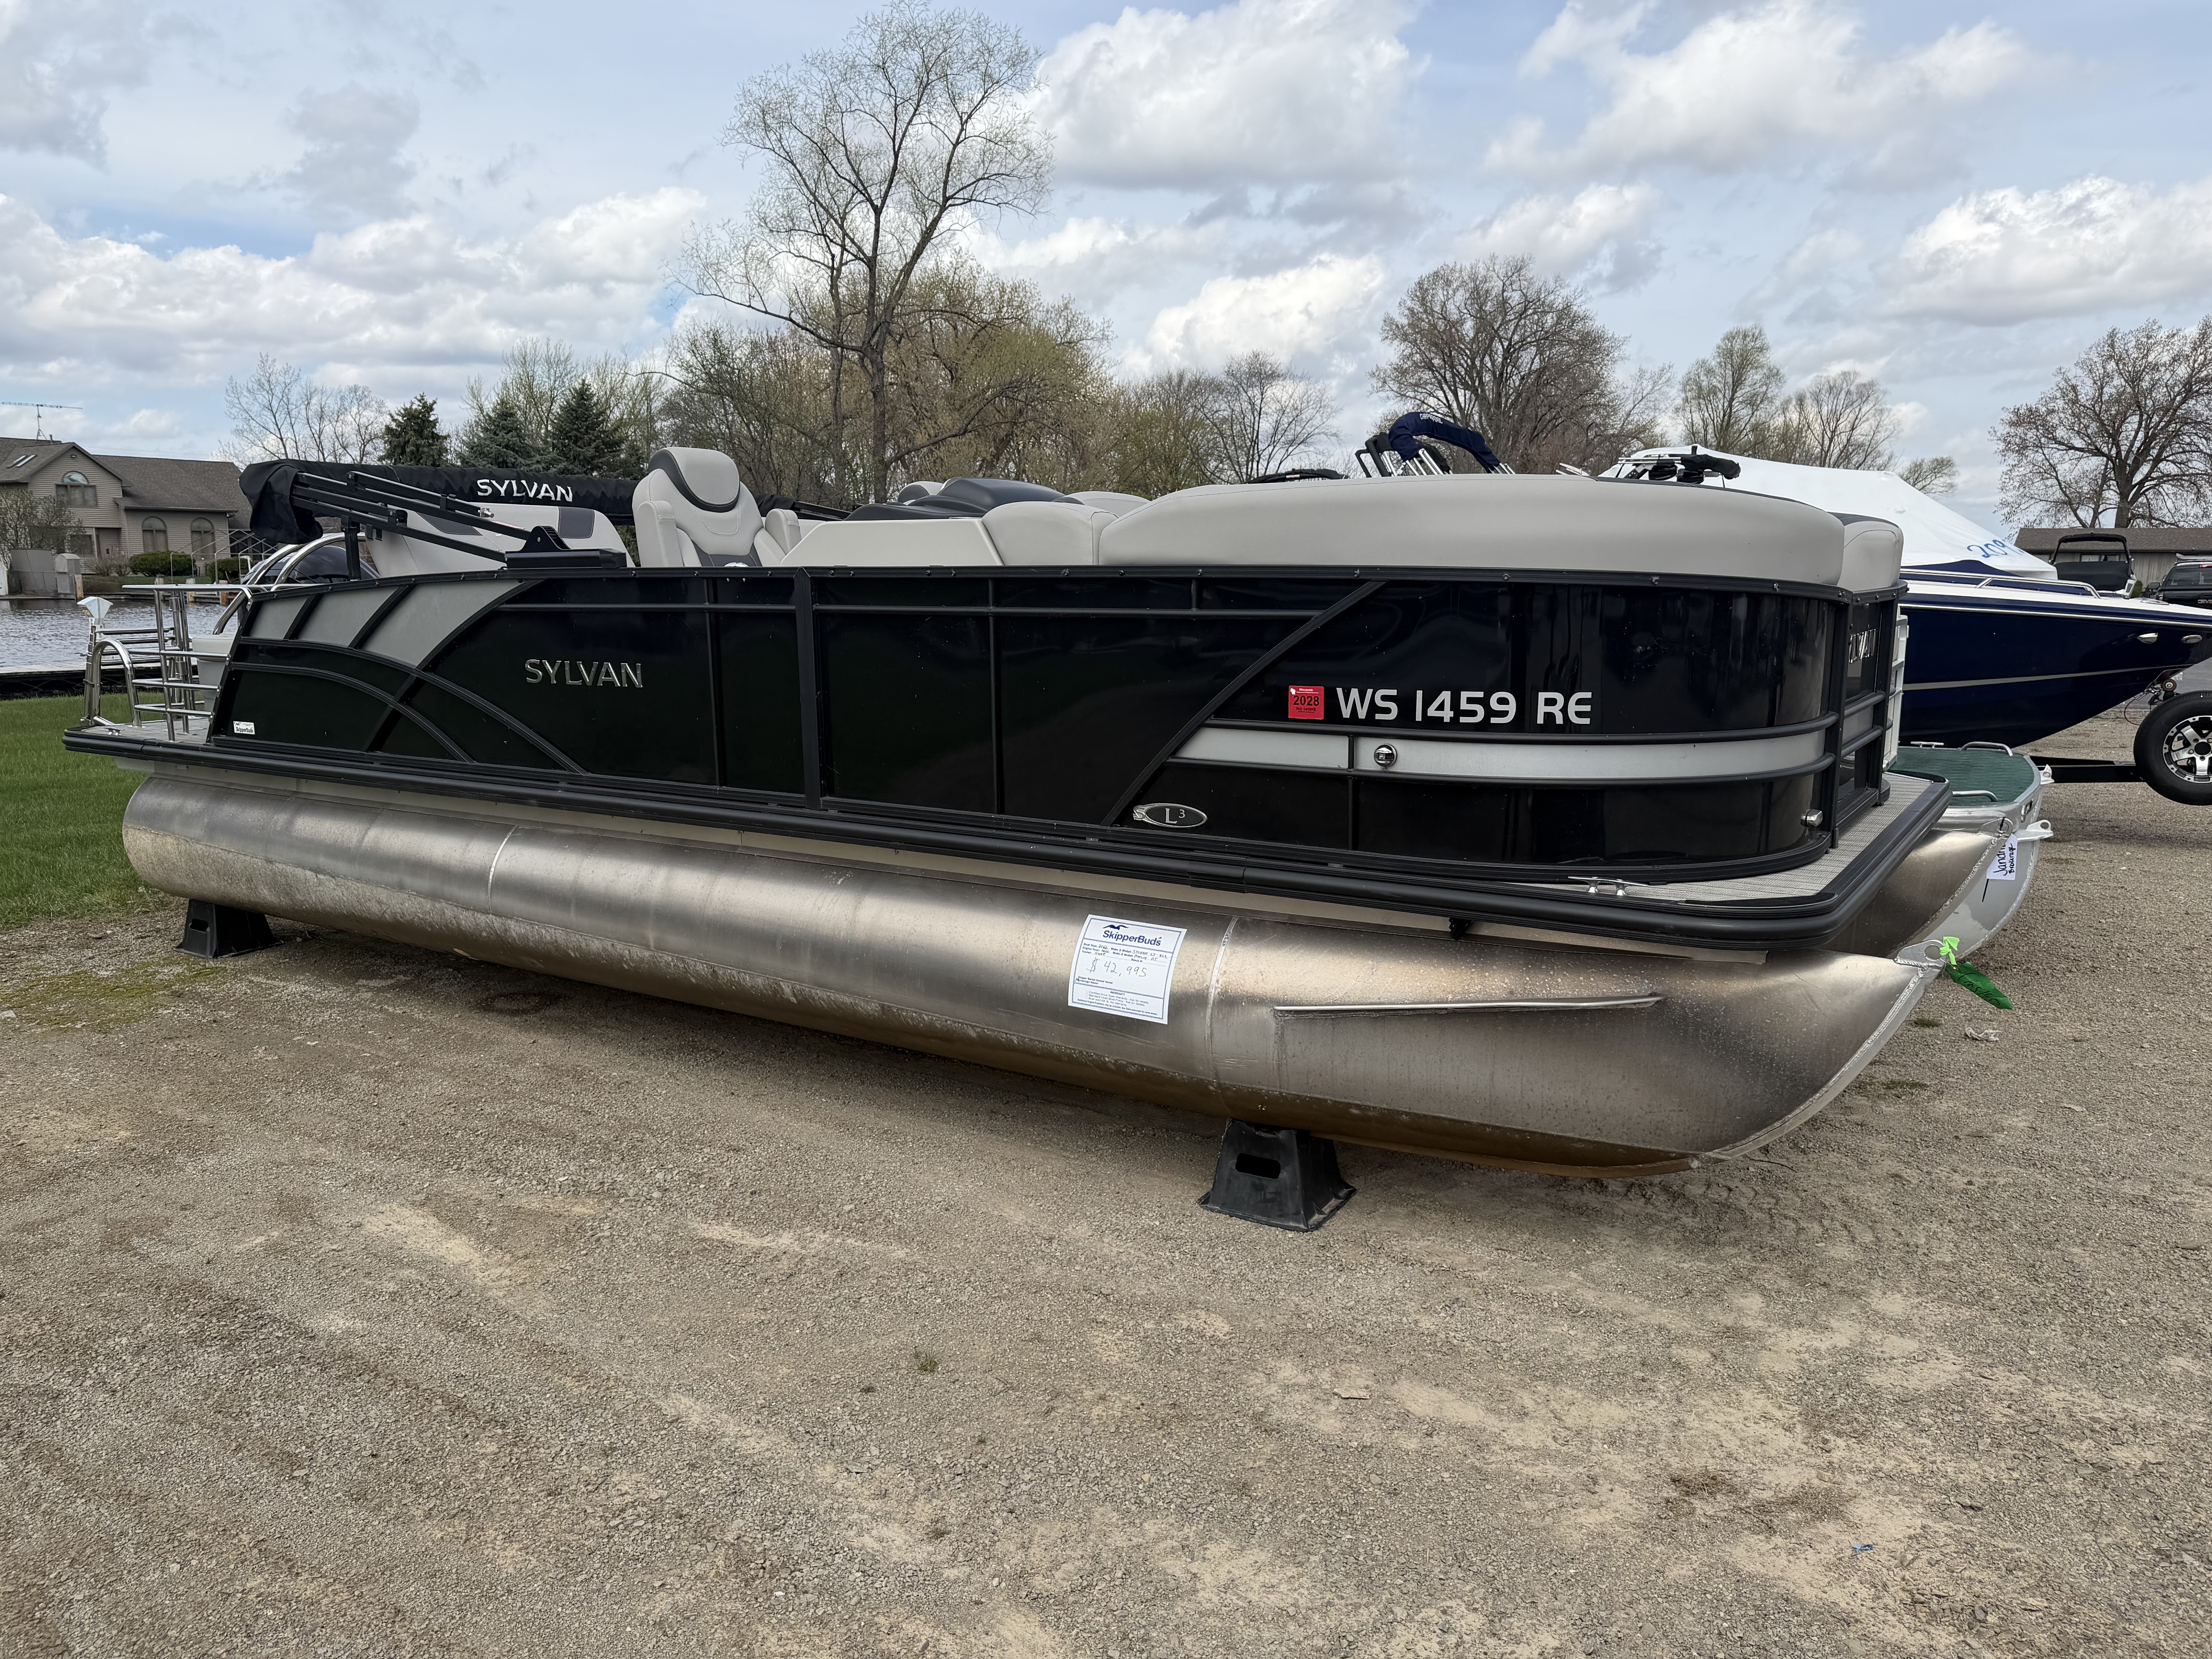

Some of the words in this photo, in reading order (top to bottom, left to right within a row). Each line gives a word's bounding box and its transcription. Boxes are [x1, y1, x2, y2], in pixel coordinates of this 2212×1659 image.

[477, 479, 573, 502] SYLVAN
[525, 659, 643, 688] SYLVAN
[1293, 695, 1319, 706] 2028
[1336, 687, 1398, 720] WS
[1415, 690, 1516, 724] 1459
[1537, 692, 1592, 725] RE
[1086, 957, 1101, 974] $
